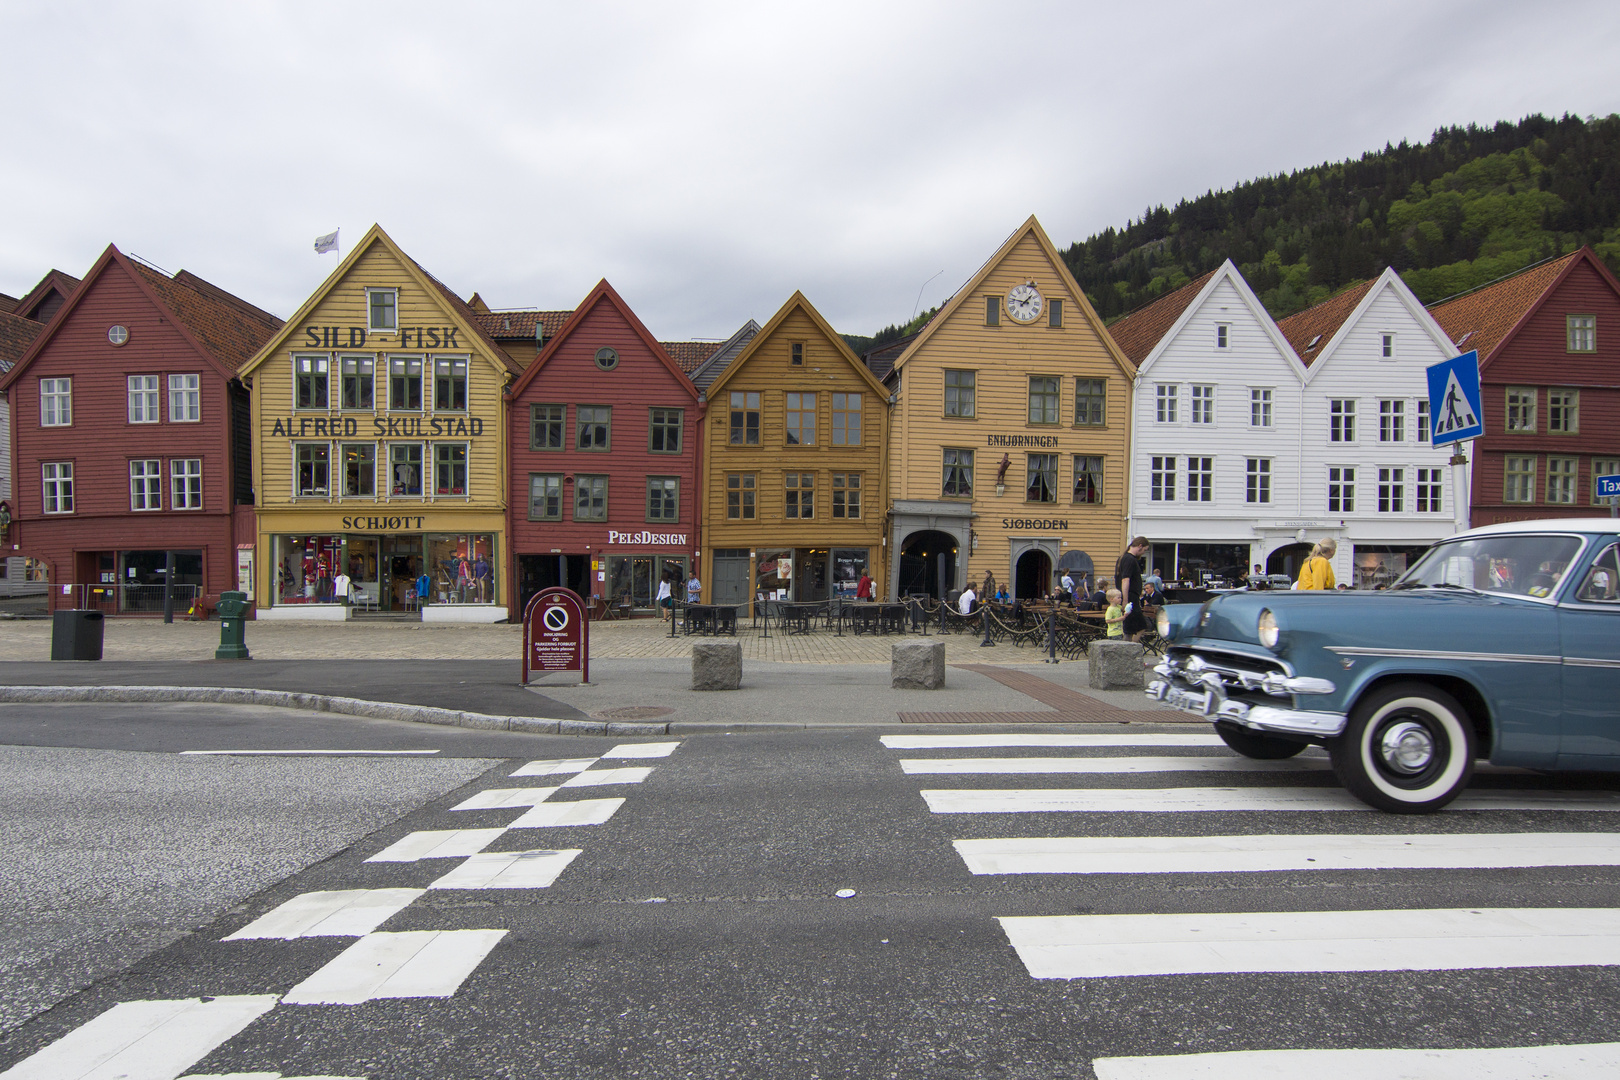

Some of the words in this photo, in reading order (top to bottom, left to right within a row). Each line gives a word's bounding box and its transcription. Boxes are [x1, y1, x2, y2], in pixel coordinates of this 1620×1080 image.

[305, 326, 366, 348] SILD
[401, 327, 460, 348] FISK
[271, 417, 358, 437] ALFRED
[373, 417, 484, 437] SKULSTAD
[987, 434, 1059, 448] ENHJØRNINGEN
[342, 516, 425, 530] SCHJØTT
[1002, 518, 1068, 530] SJØBODEN
